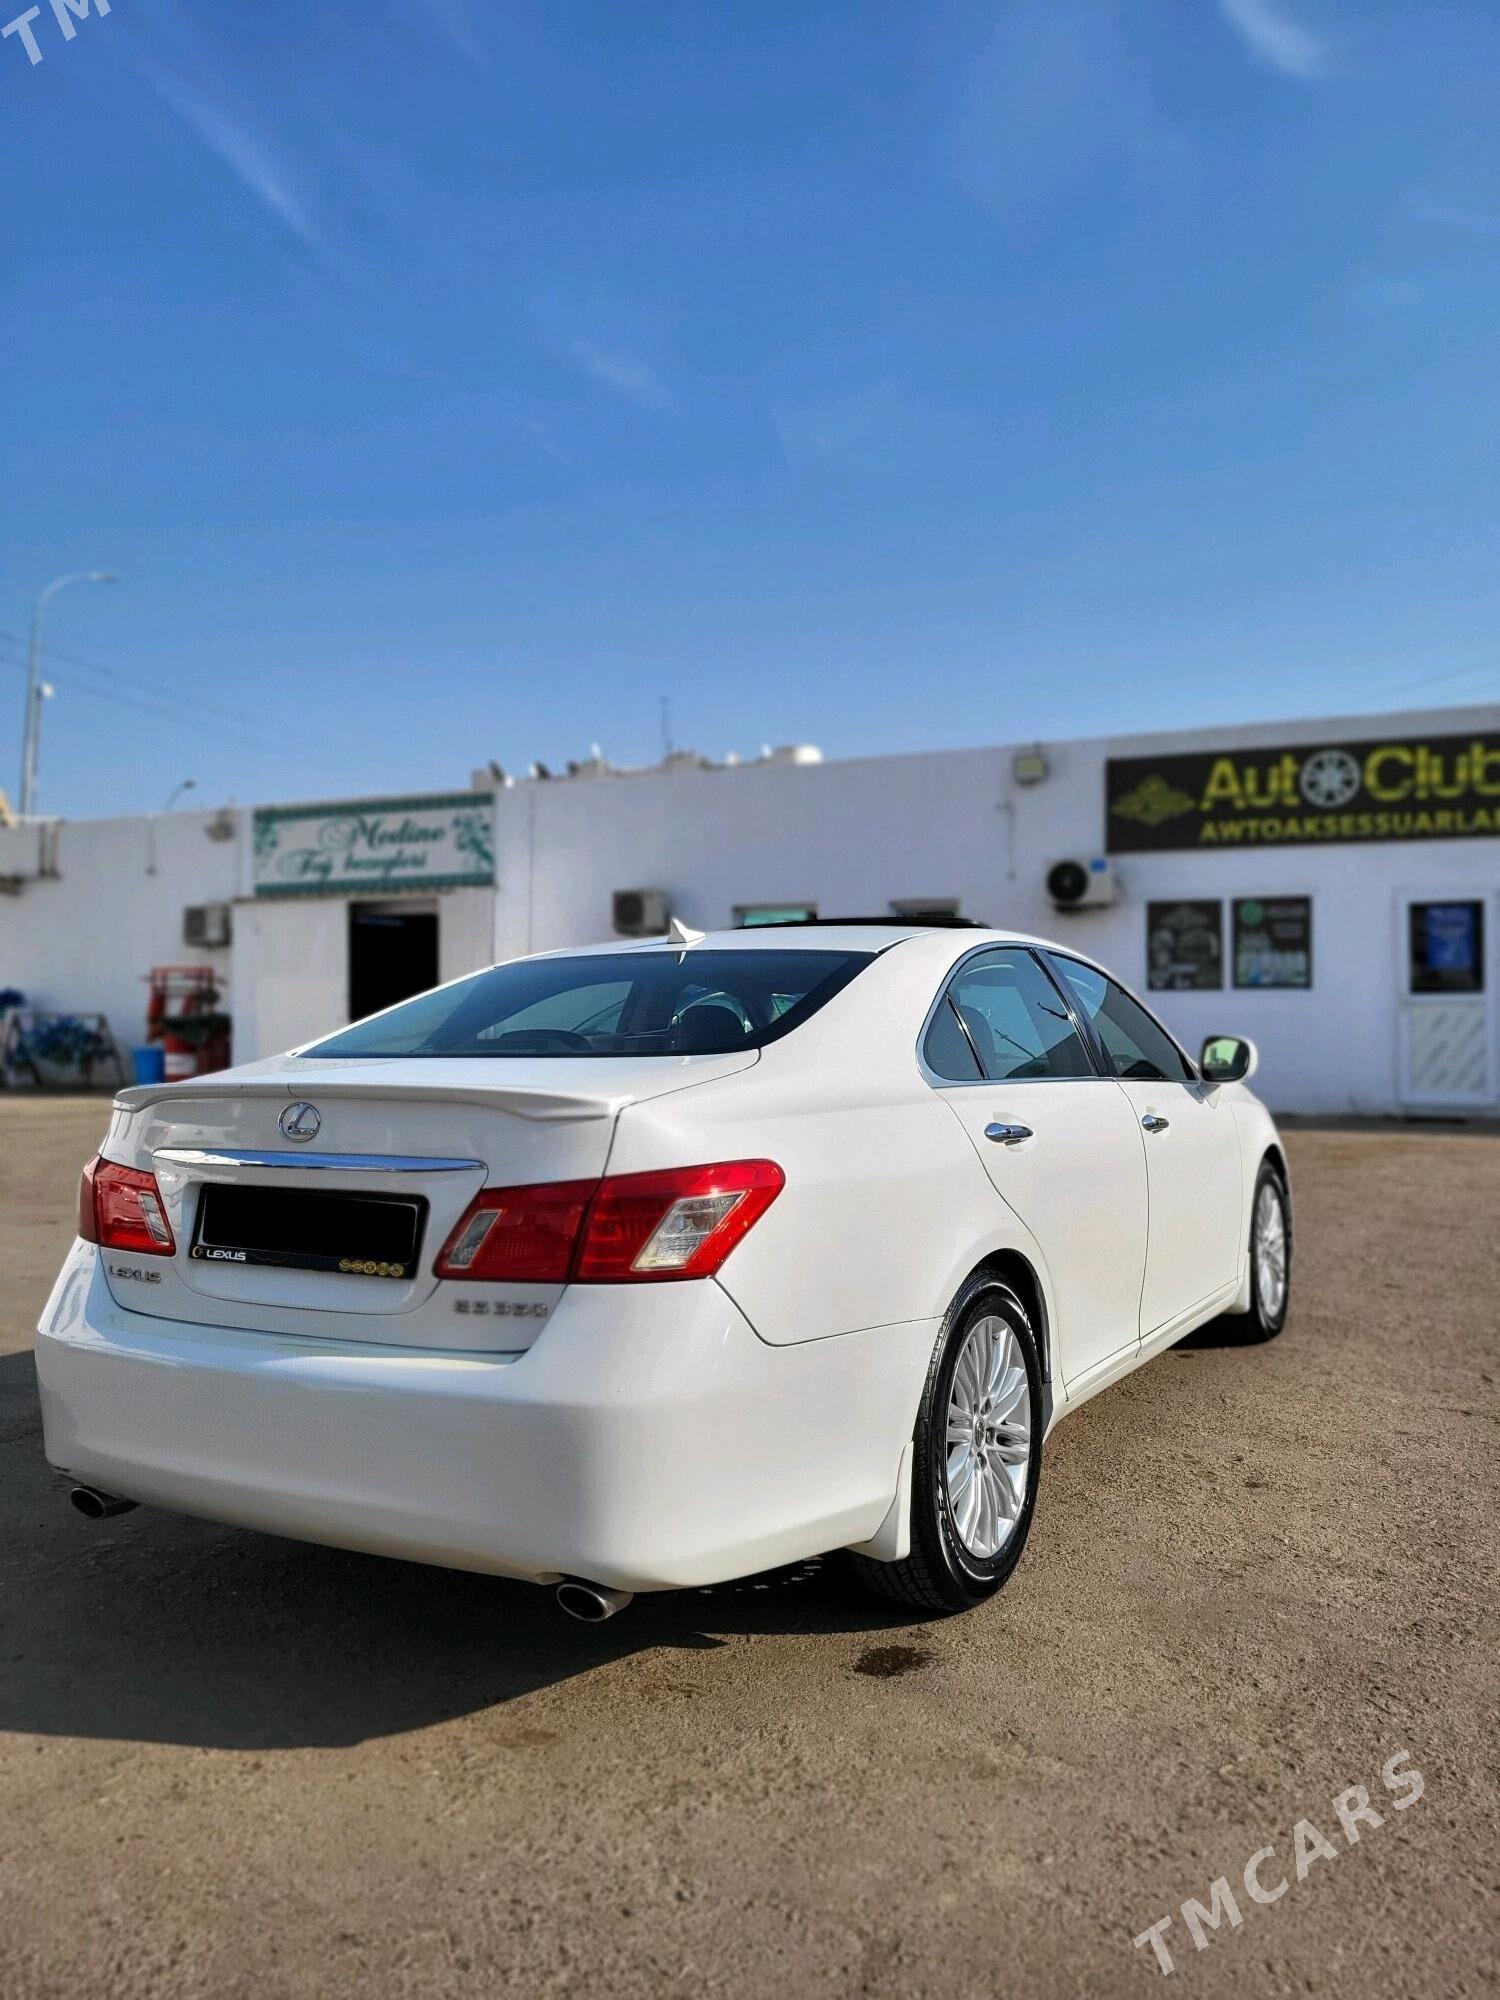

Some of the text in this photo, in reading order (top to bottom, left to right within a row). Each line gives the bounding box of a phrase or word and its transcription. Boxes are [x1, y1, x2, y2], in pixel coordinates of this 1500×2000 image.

[1200, 808, 1500, 842] AWTOAKSESSUARLA
[206, 1249, 247, 1261] LEXUS
[109, 1265, 162, 1284] LEXUS
